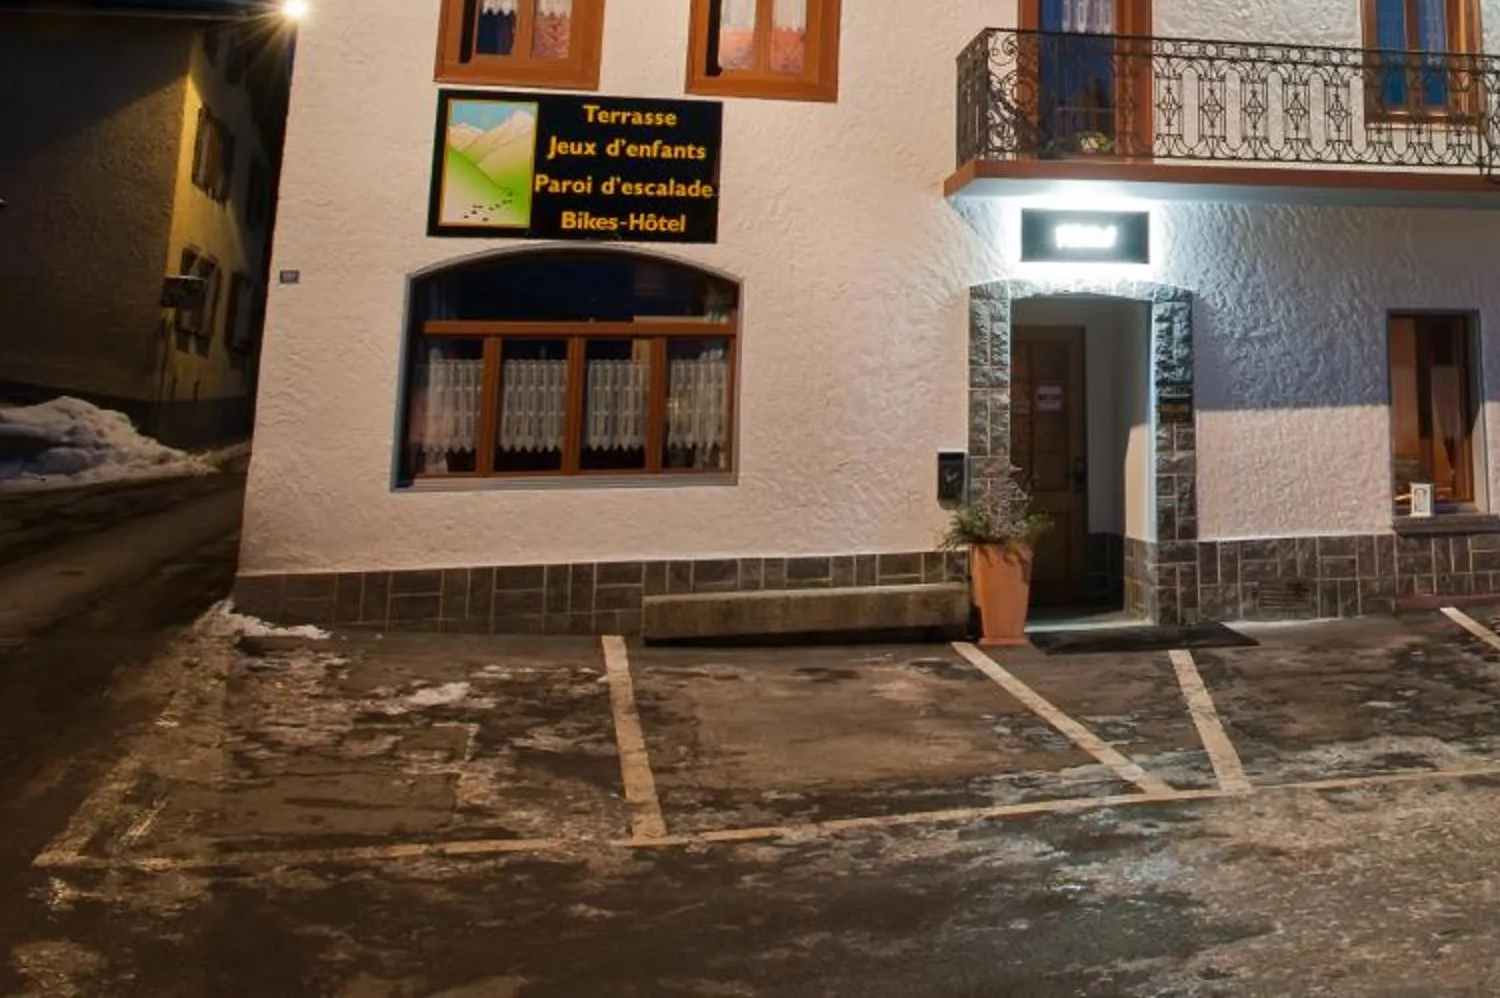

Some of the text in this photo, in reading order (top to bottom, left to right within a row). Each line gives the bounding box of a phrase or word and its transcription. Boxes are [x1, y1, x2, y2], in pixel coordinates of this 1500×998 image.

[583, 105, 677, 126] Terrasse
[547, 136, 706, 159] Jeux d'enfants
[534, 174, 713, 198] Paroi d'escalade
[561, 211, 685, 232] Bikes-Hôtel
